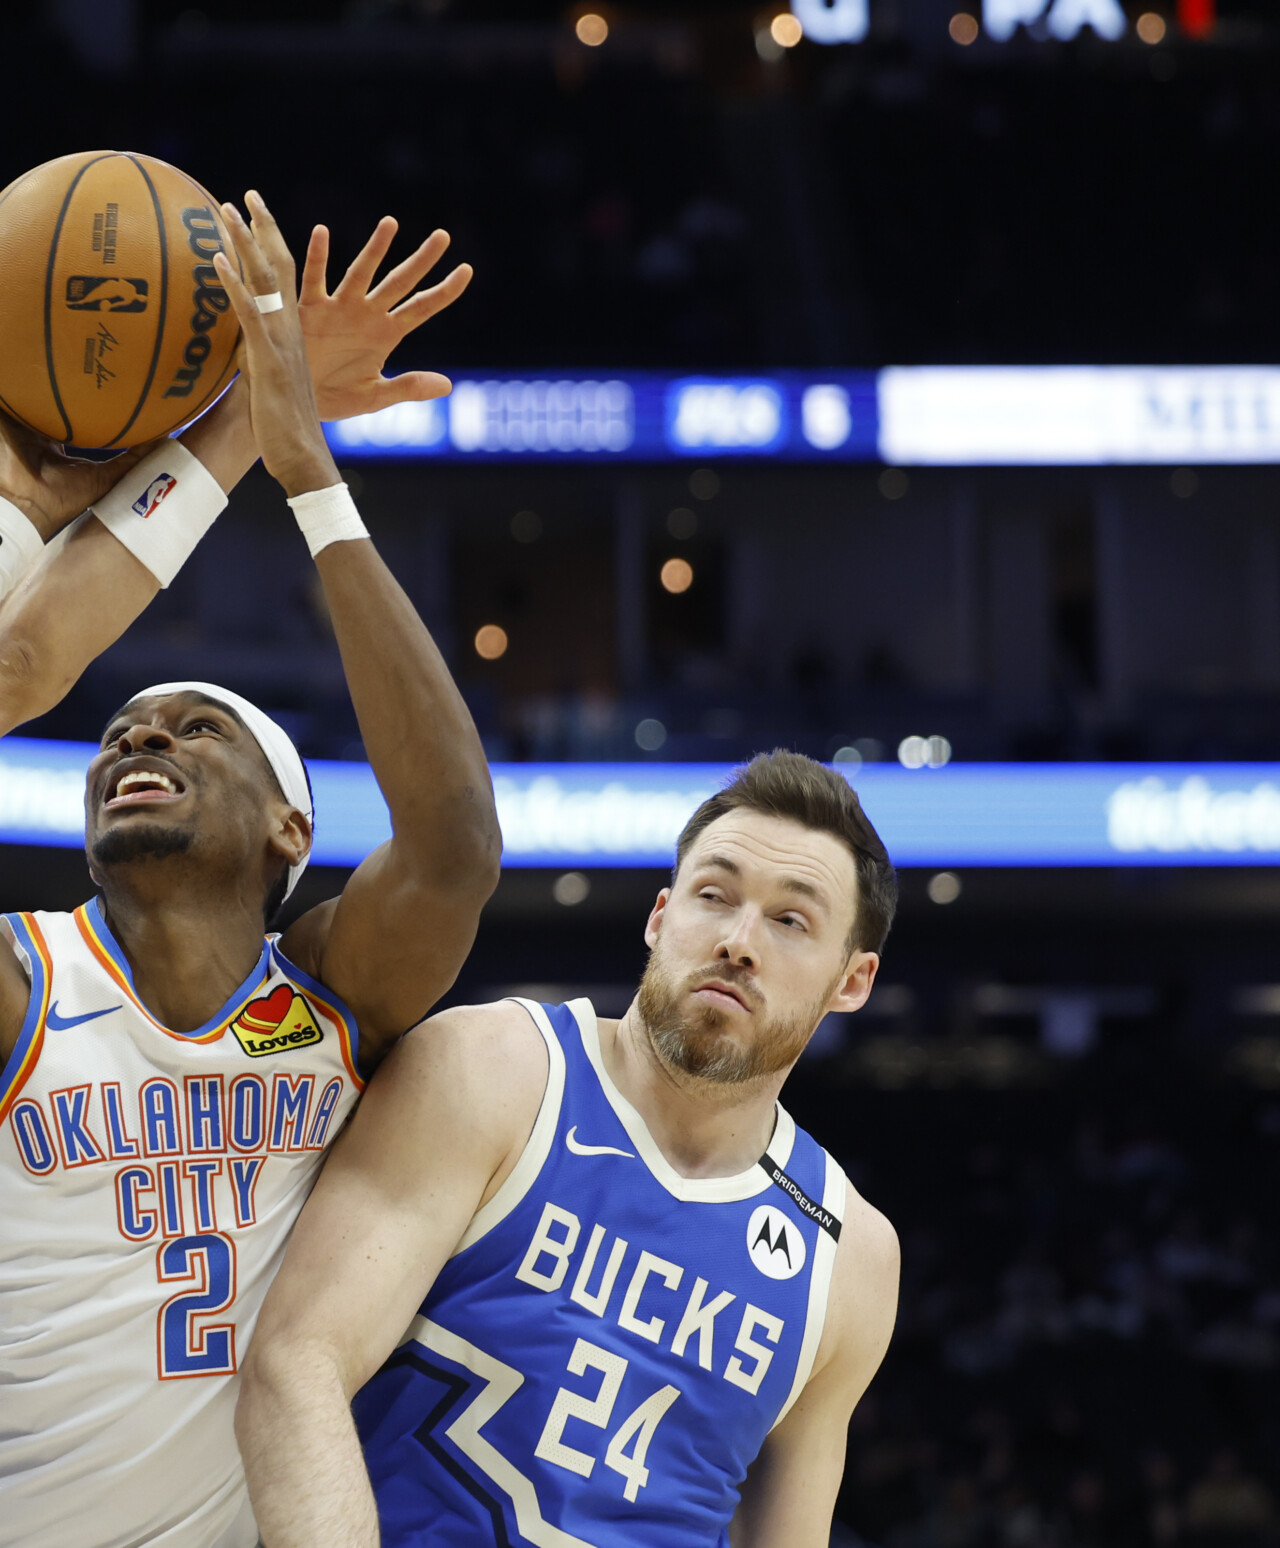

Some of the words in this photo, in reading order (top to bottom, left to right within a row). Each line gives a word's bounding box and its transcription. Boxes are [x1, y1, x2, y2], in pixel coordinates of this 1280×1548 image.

[103, 248, 116, 264] BALL
[10, 1073, 344, 1176] OKLAHOMA
[114, 1156, 267, 1242] CITY
[772, 1168, 833, 1228] BRIDGEMAN
[156, 1231, 238, 1381] 2
[515, 1202, 785, 1396] BUCKS
[534, 1338, 681, 1504] 24
